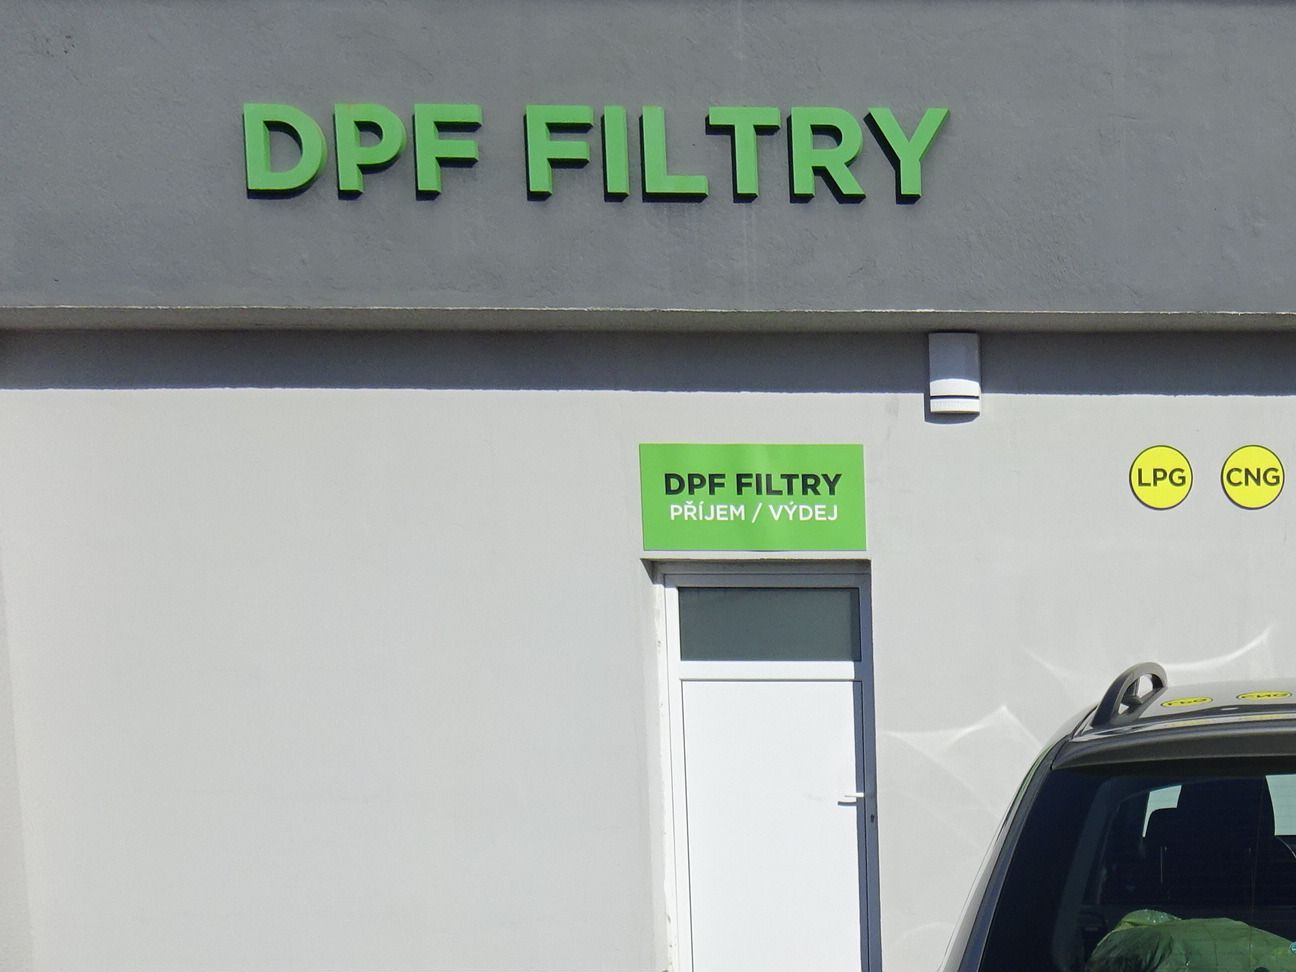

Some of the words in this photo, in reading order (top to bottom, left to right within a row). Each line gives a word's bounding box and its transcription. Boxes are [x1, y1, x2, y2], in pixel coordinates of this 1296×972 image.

[243, 102, 482, 196] DPF
[525, 104, 950, 199] FILTRY
[664, 473, 726, 496] DPF
[736, 473, 842, 496] FILTRY
[1137, 467, 1187, 487] LPG
[1226, 467, 1280, 487] CNG
[670, 500, 745, 521] PŘÍJEM
[769, 500, 838, 521] VÝDEJ
